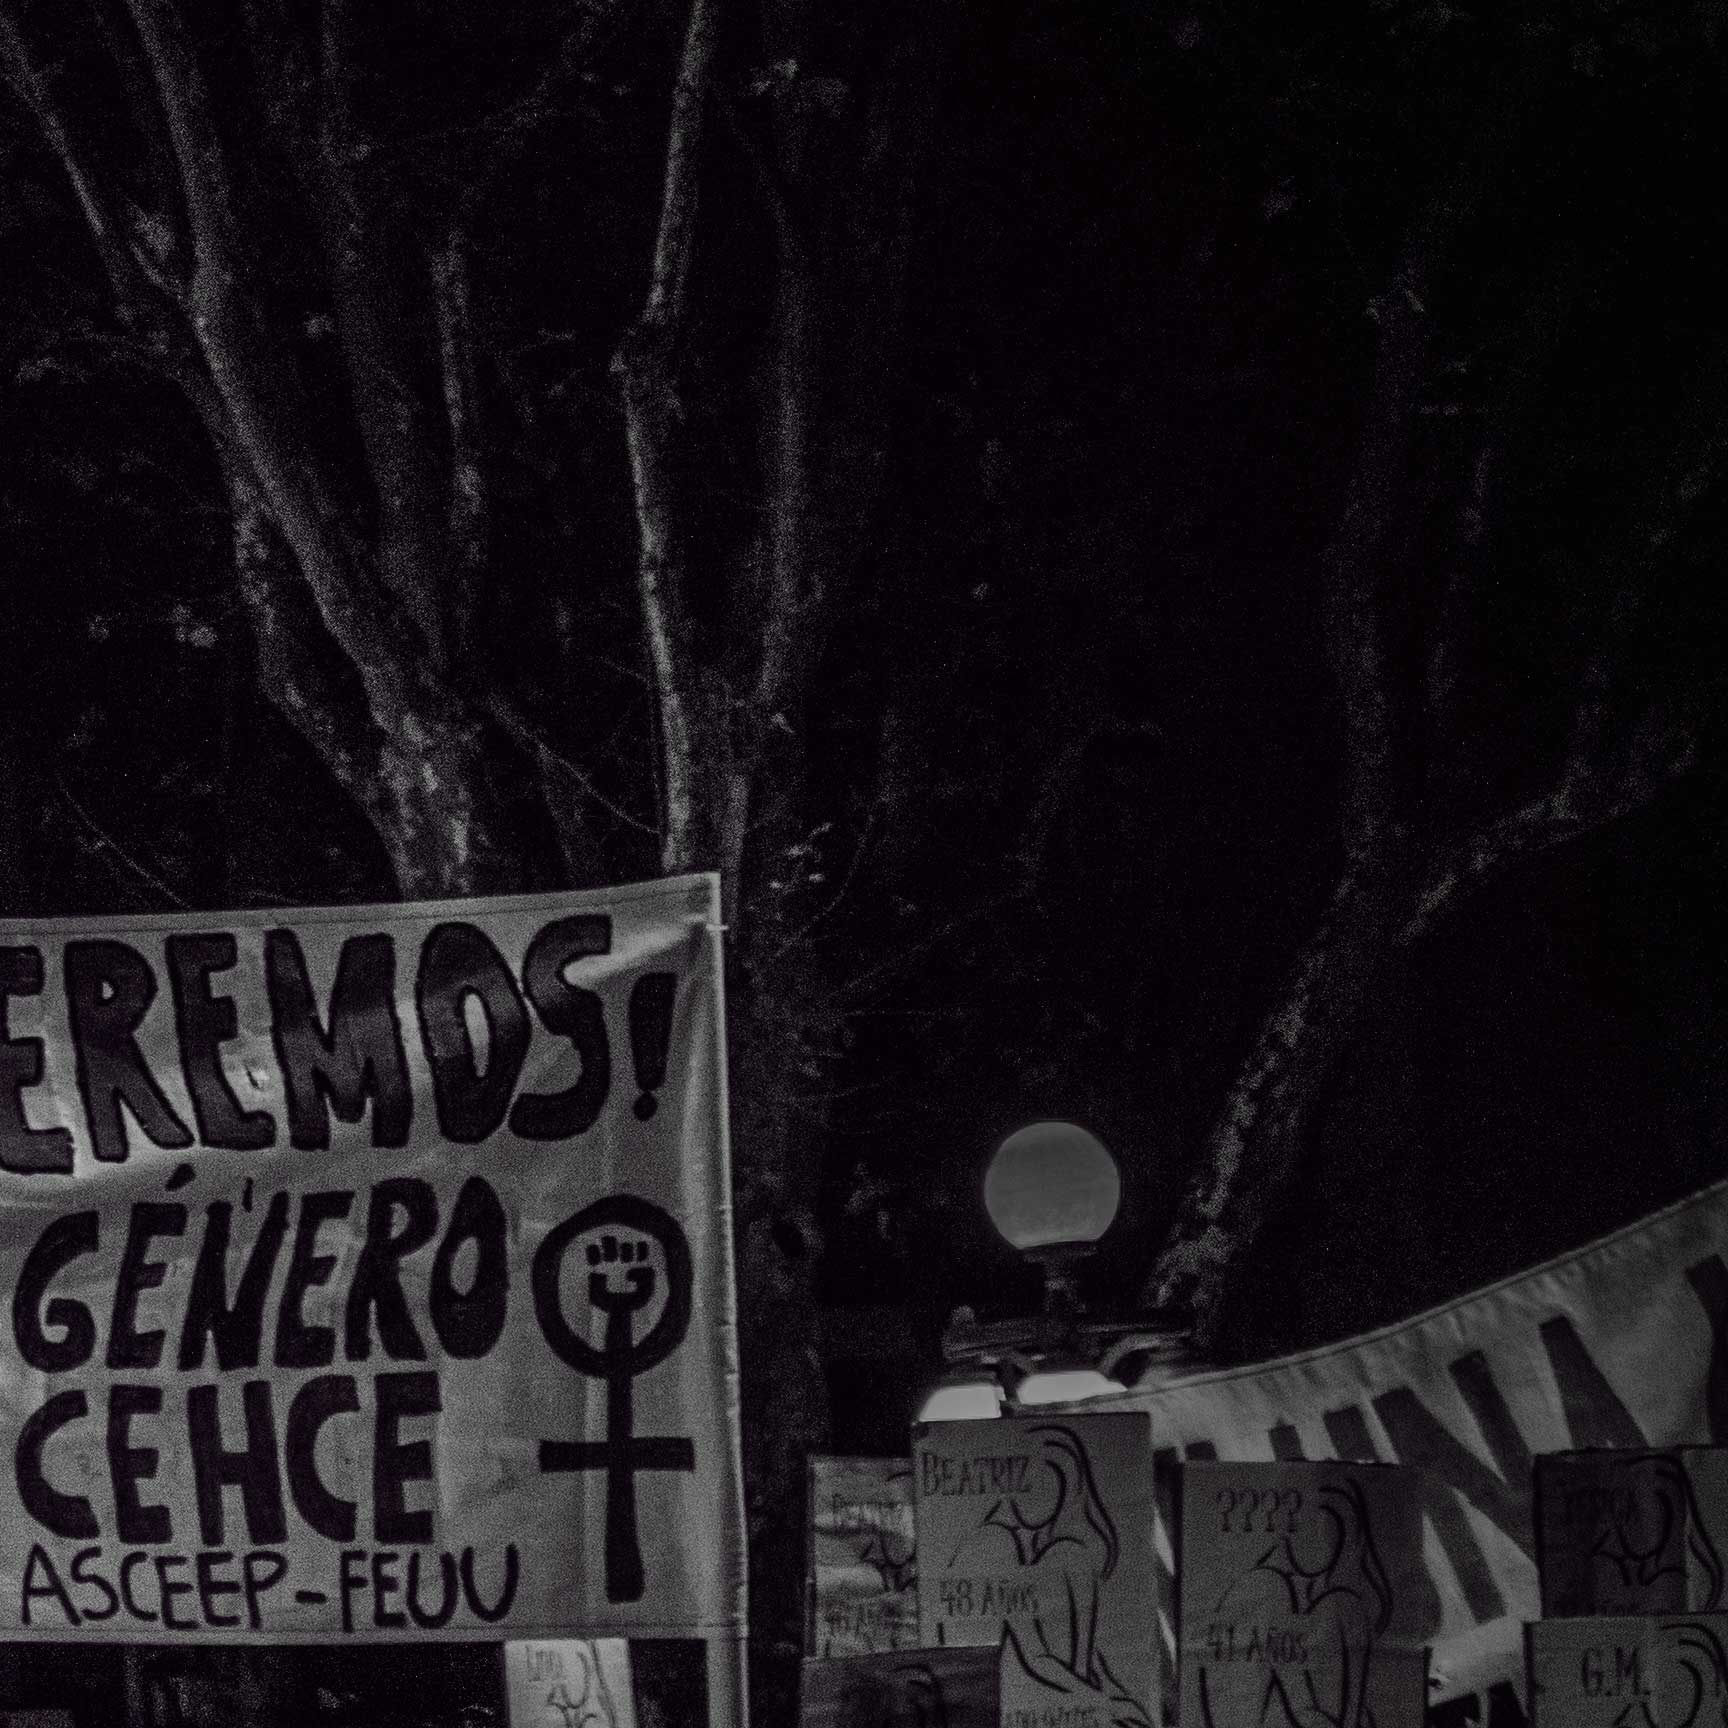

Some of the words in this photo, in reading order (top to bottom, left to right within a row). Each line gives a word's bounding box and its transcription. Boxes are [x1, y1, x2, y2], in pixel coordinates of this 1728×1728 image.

[14, 1163, 510, 1374] GÉNERO
[16, 1371, 443, 1546] CEHCE
[921, 1451, 1035, 1498] BEATRIZ
[22, 1544, 519, 1633] ASCEEP-FEUU
[981, 1578, 1041, 1617] AÑOS
[1246, 1625, 1310, 1665] AÑOS
